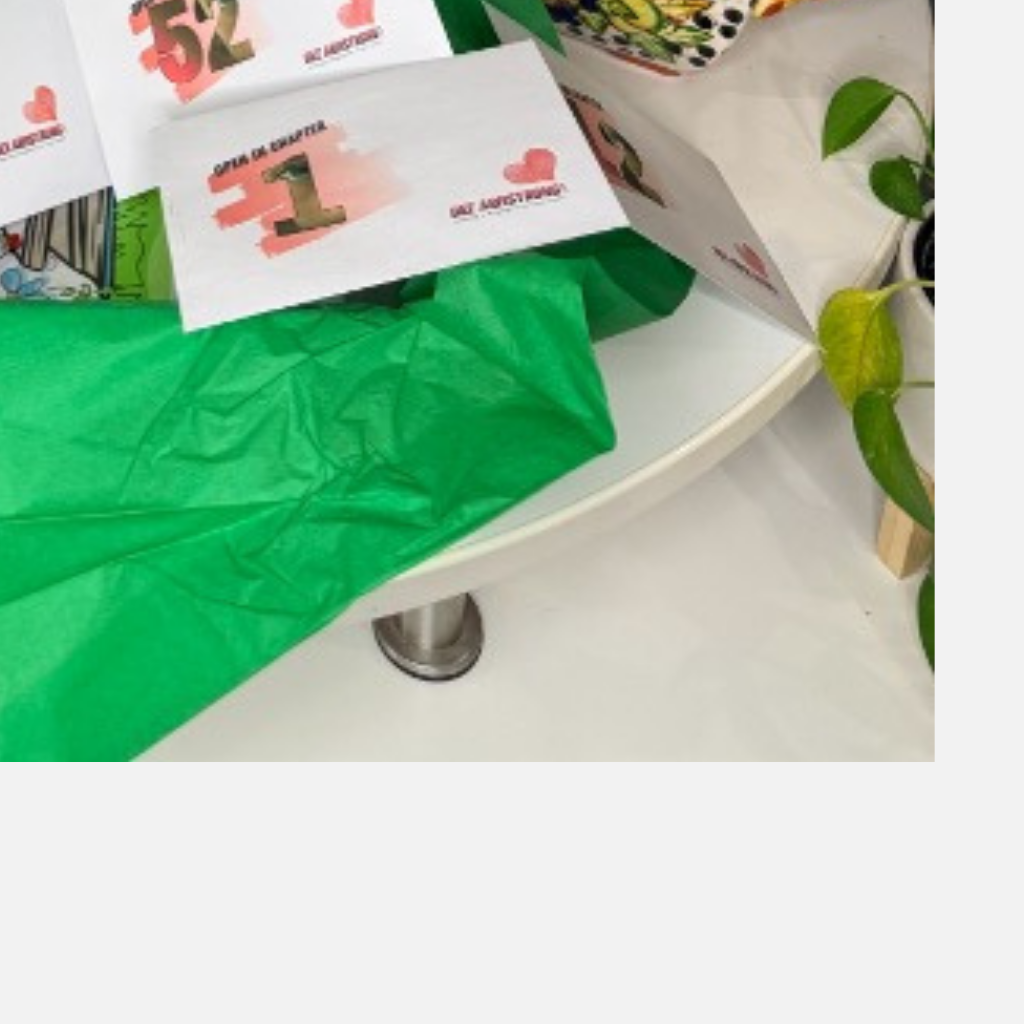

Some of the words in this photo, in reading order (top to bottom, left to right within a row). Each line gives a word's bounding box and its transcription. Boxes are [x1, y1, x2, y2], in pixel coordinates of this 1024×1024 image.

[213, 155, 249, 178] OPEN
[251, 145, 268, 162] IN
[270, 119, 327, 153] CHAPTER
[261, 152, 347, 237] 1
